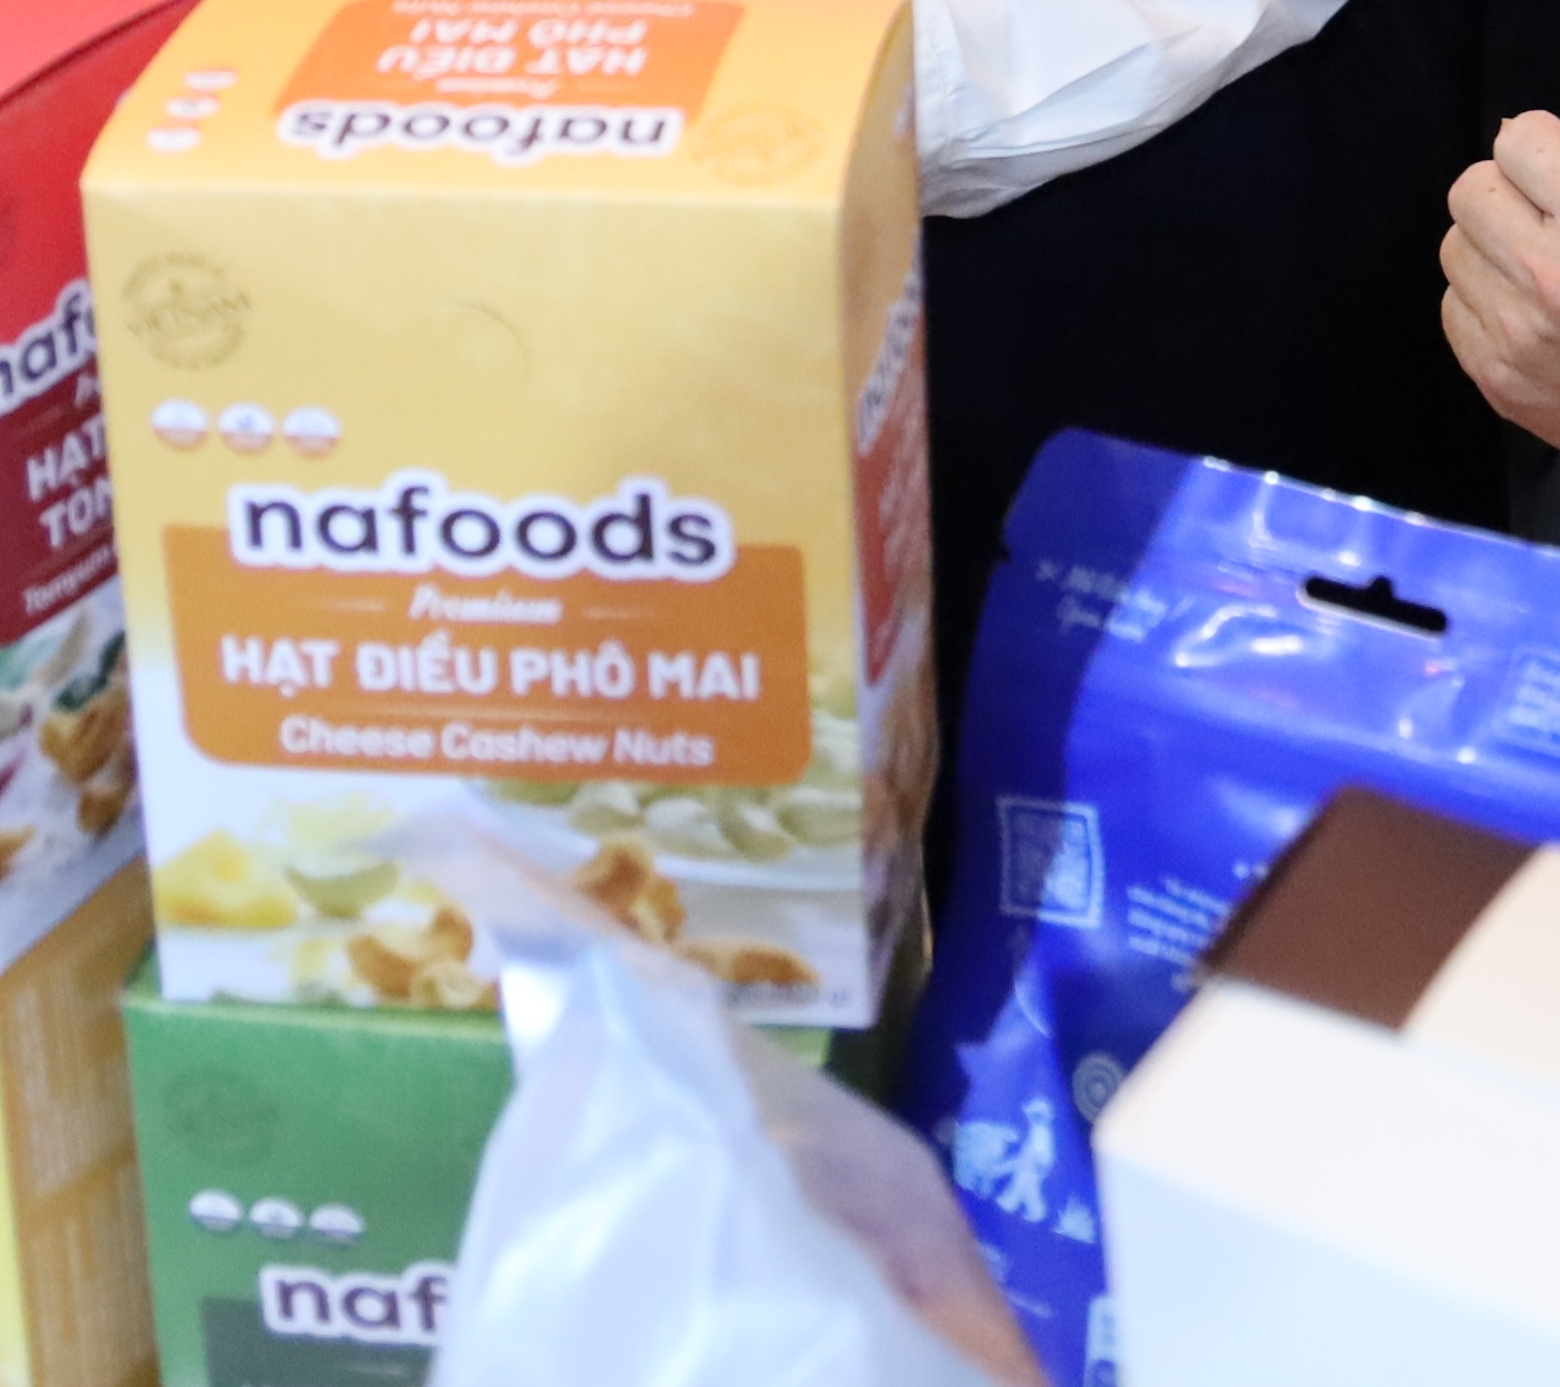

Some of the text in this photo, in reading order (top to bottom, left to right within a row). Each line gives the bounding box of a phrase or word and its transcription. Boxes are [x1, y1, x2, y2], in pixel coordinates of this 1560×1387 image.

[290, 109, 670, 159] nafoods
[244, 483, 719, 568] nafoods
[220, 628, 761, 701] HẠT ĐIỀU PHÔ MAI
[280, 714, 715, 768] Cheese Cashew Nuts
